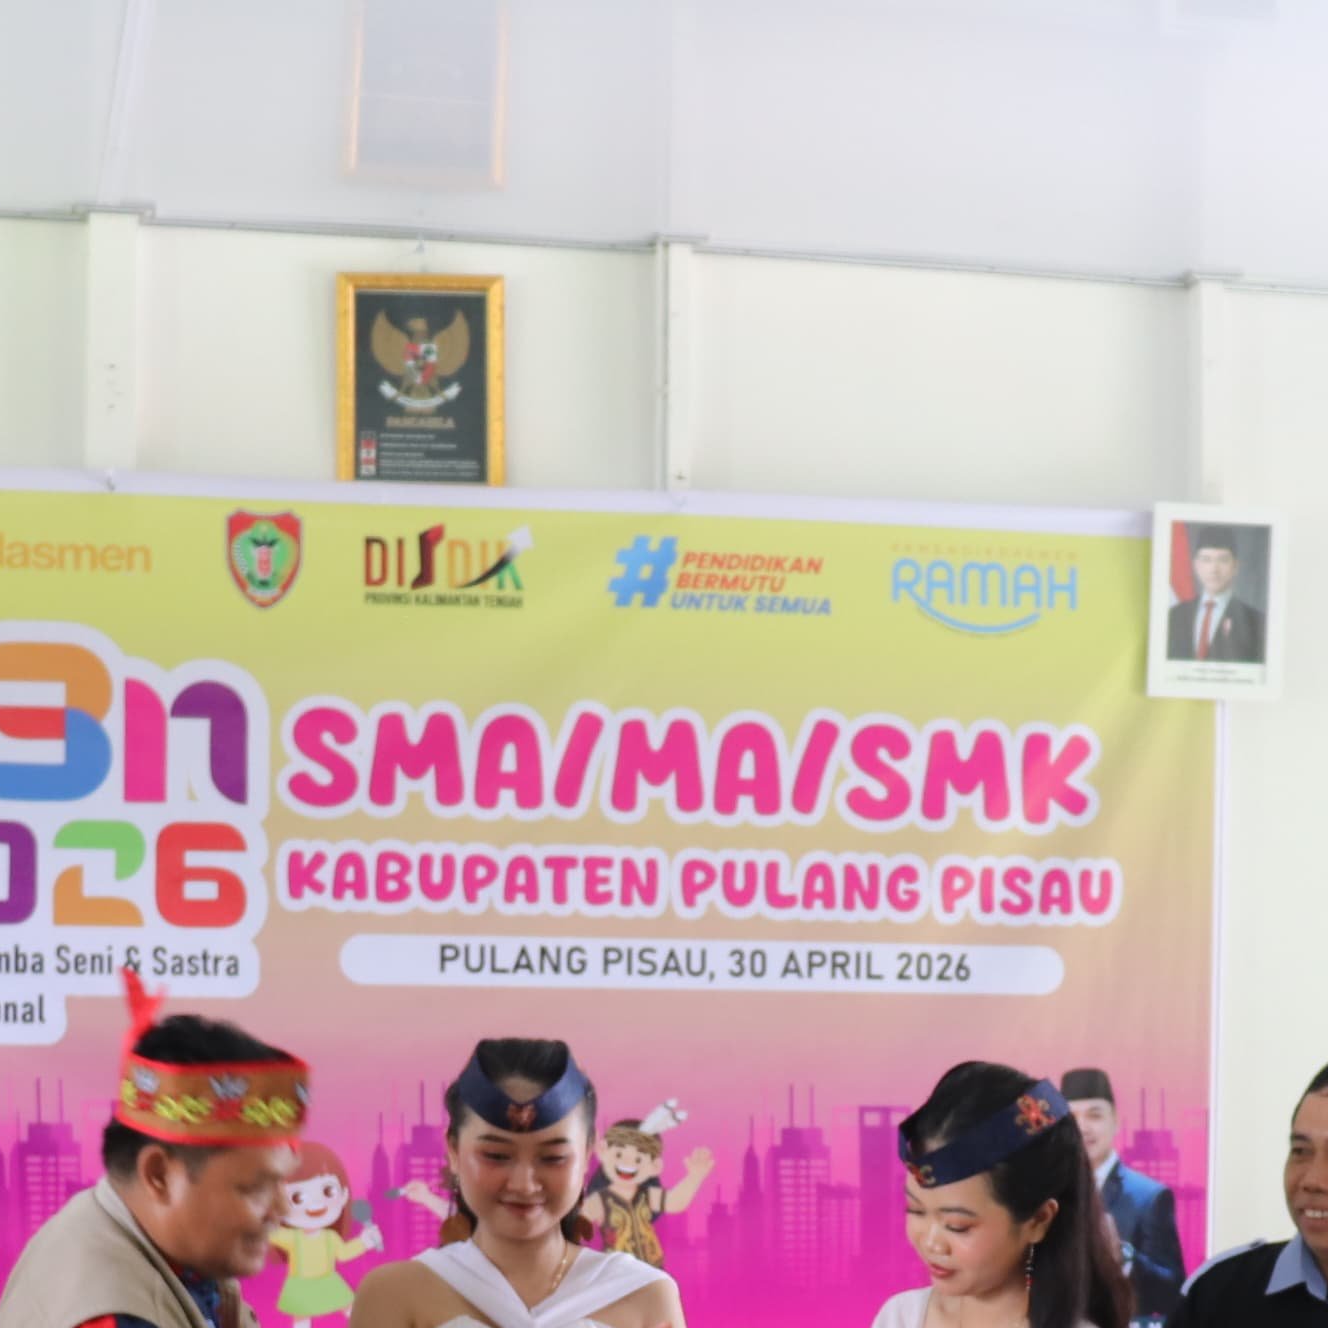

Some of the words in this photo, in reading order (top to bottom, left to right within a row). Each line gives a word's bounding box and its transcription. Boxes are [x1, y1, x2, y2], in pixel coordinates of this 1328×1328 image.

[682, 551, 824, 574] PENDIDIKAN
[676, 572, 786, 593] BERMUTU
[891, 557, 1078, 634] RAMAH
[670, 592, 749, 611] UNTUK
[753, 595, 832, 615] SEMUA
[287, 706, 1092, 825] SMA/MA/SMK
[288, 850, 659, 907] KABUPATEN
[681, 858, 921, 912] PULANG
[940, 865, 1113, 916] PISAU
[56, 945, 113, 976] Seni
[152, 945, 240, 977] Sastra
[439, 943, 588, 976] PULANG
[602, 946, 716, 982] PISAU,
[727, 949, 768, 979] 30
[780, 950, 884, 981] APRIL
[895, 951, 972, 982] 2026
